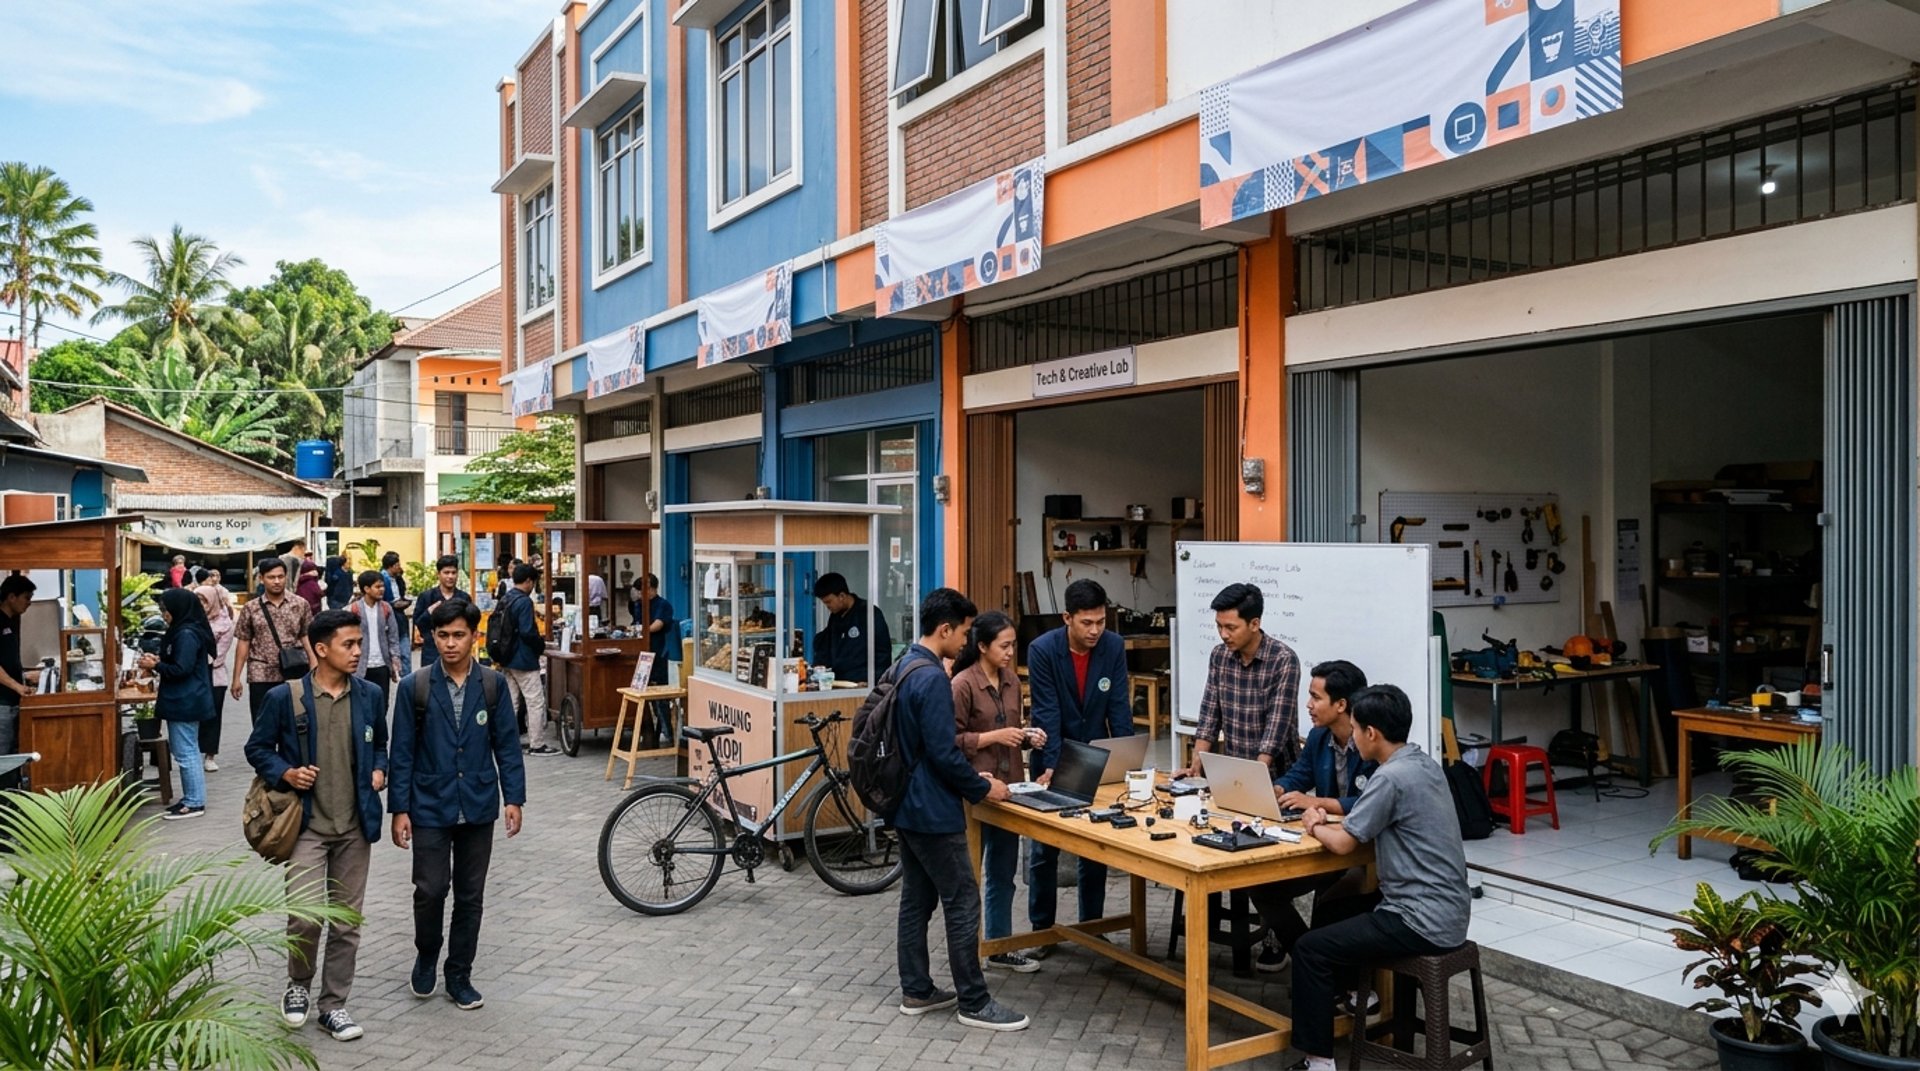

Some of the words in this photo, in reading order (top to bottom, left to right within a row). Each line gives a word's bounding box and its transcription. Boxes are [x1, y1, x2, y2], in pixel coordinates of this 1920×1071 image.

[1036, 370, 1058, 386] Tech
[1060, 368, 1066, 383] &
[1068, 363, 1108, 382] Creative
[177, 518, 223, 531] Warung
[226, 517, 252, 531] Kopi
[708, 700, 752, 733] WARUNG
